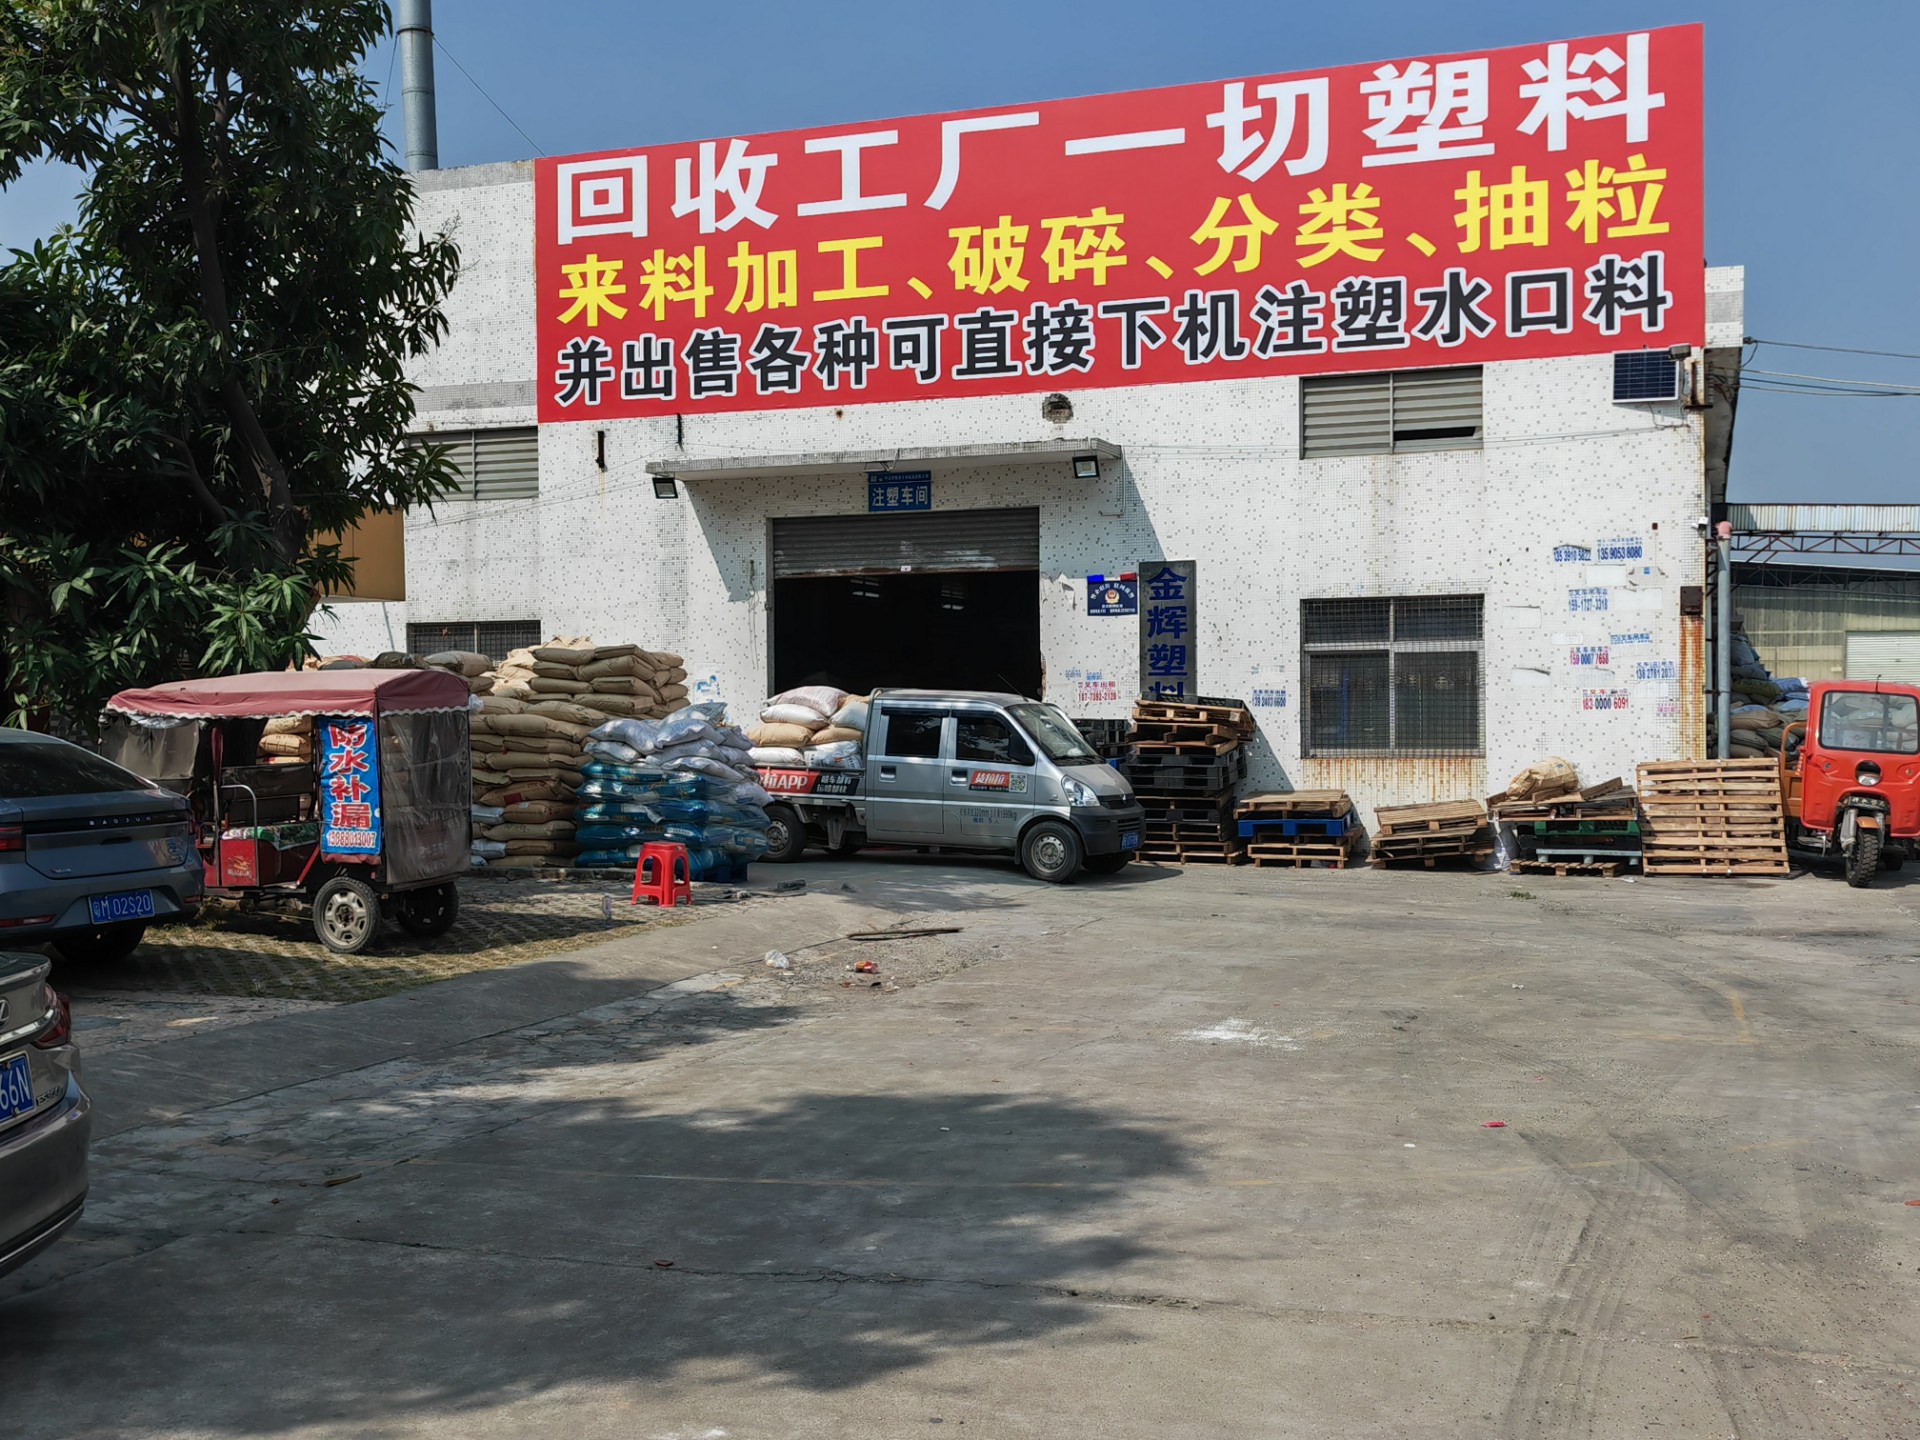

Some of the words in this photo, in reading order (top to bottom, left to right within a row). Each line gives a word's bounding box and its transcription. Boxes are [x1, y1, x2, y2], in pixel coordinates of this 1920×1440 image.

[556, 32, 1666, 246] 回收工厂一切塑料
[554, 250, 1673, 408] 并出售各种可直接下机注塑水口料
[872, 485, 928, 507] 注塑车间
[328, 724, 371, 829] 防水补漏
